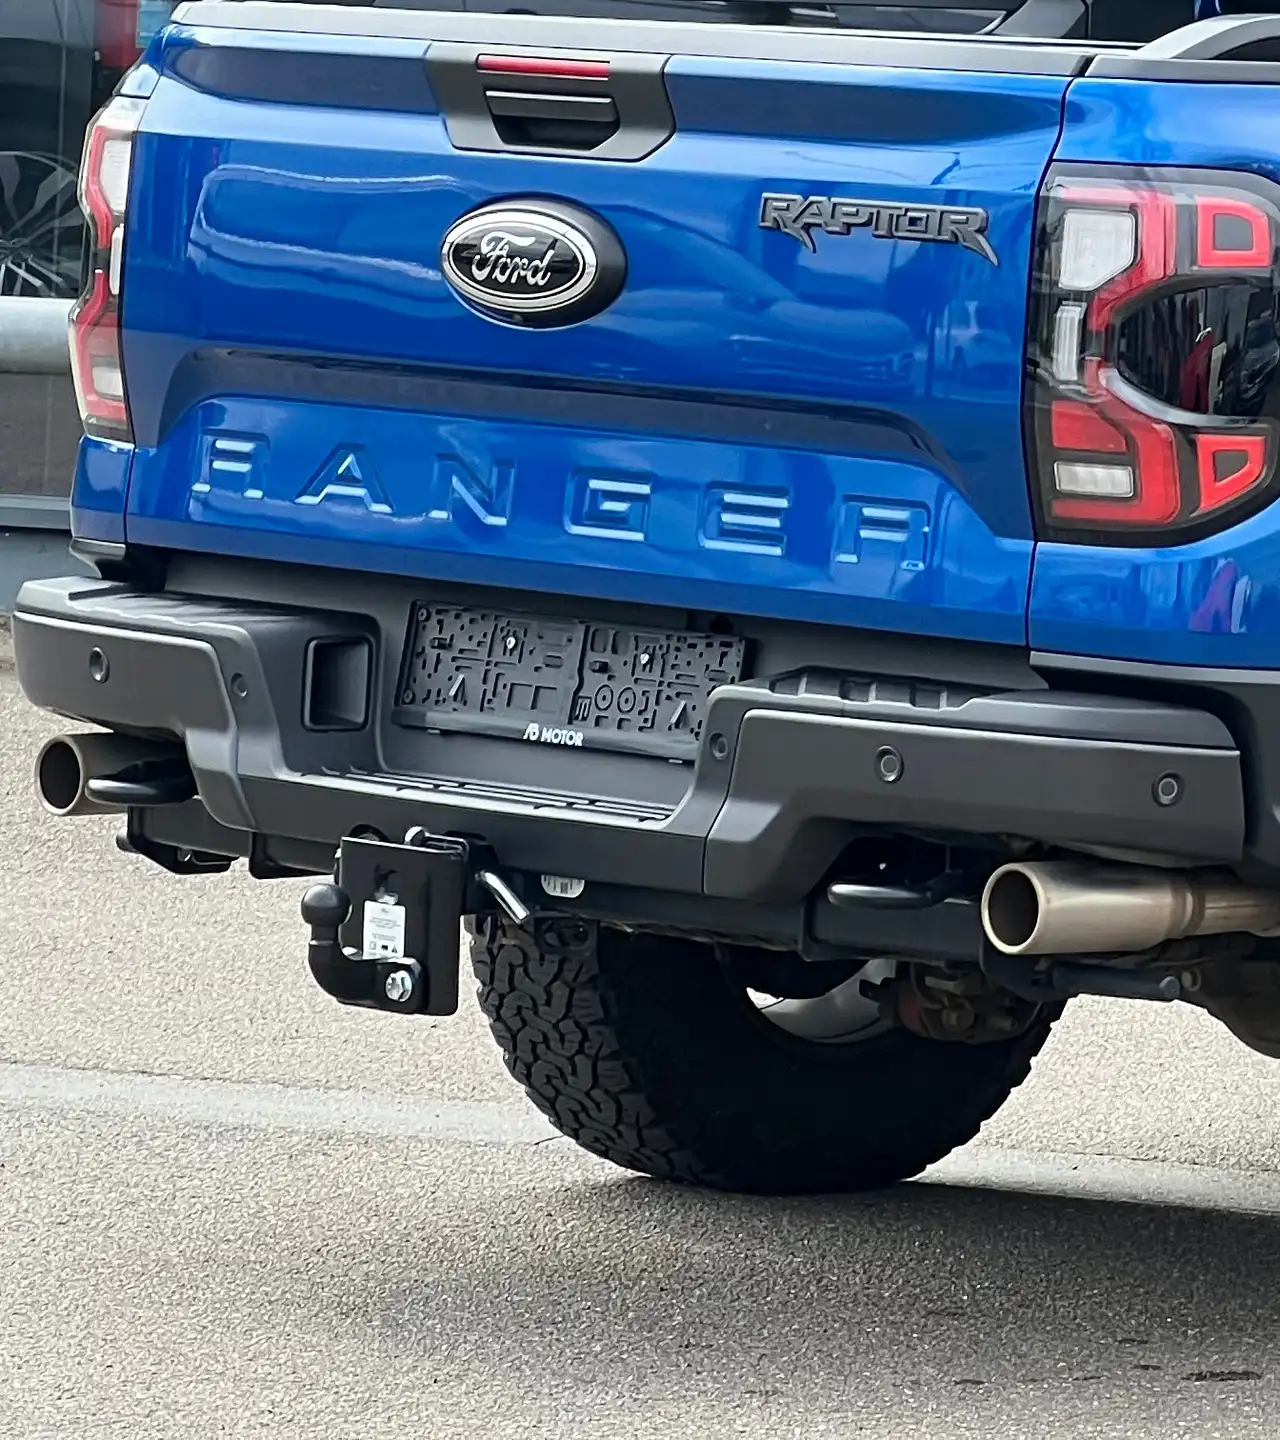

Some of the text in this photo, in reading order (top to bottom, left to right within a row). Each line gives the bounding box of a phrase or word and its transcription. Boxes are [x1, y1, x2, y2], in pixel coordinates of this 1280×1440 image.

[471, 231, 556, 287] Ford
[758, 192, 998, 267] RAPTOR
[190, 429, 932, 571] RANGER
[540, 726, 585, 747] MOTOR
